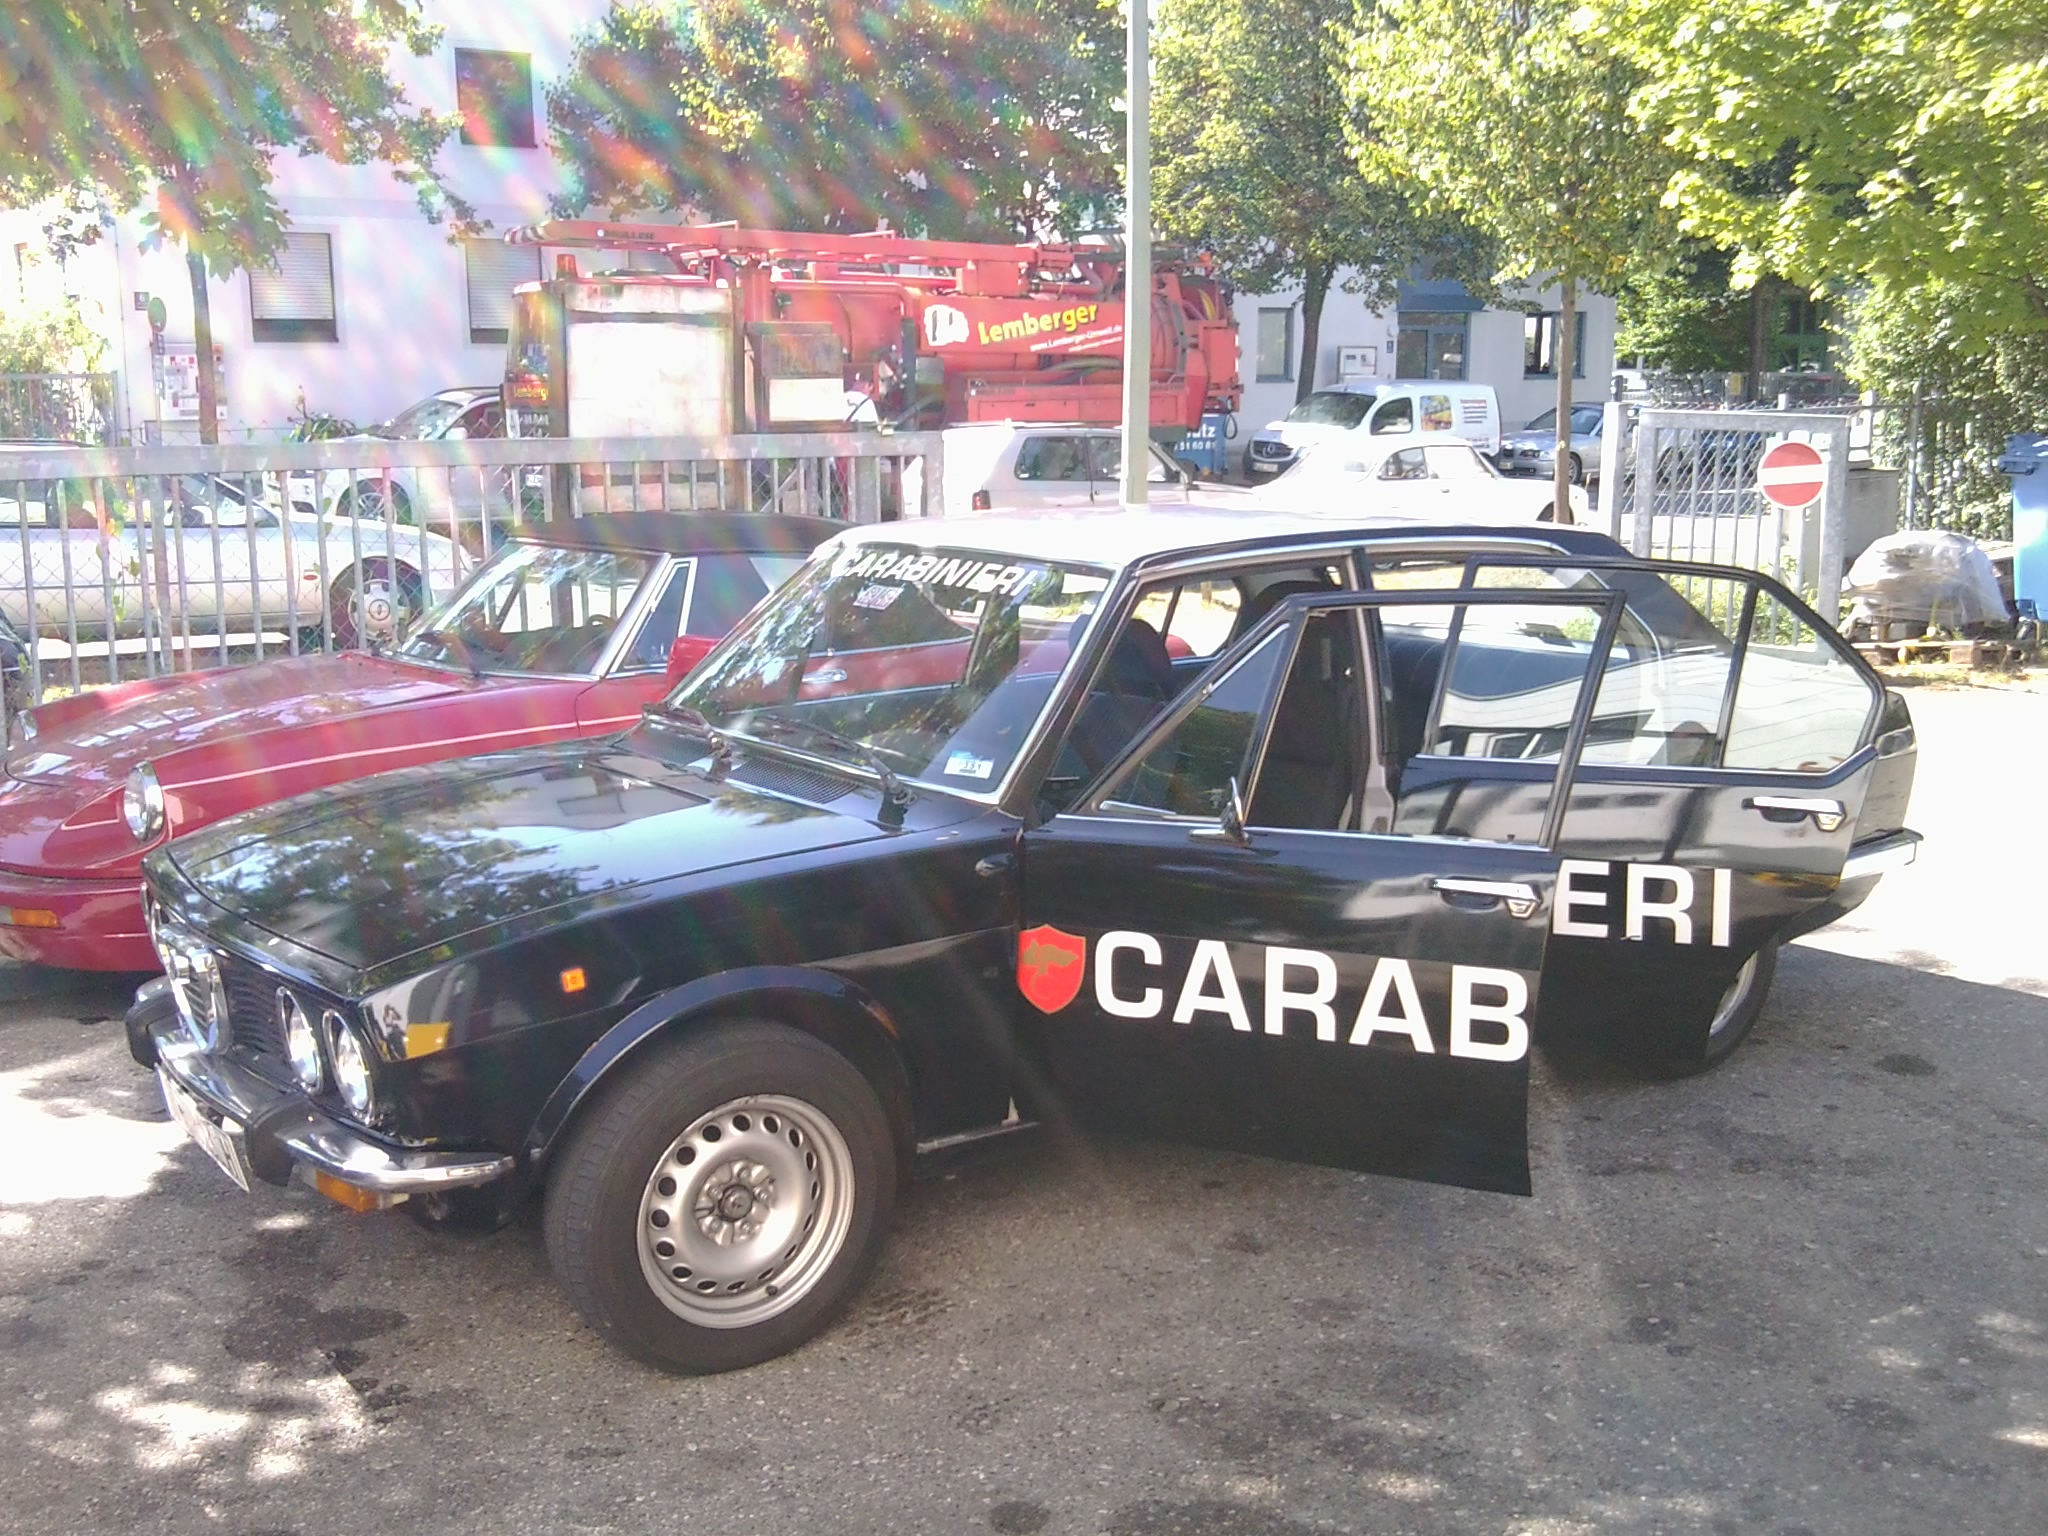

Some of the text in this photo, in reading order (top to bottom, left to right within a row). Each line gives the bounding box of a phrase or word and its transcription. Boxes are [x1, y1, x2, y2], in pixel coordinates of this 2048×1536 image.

[978, 303, 1099, 345] Lemberger
[831, 548, 1038, 597] CARABINIERI
[1552, 859, 1732, 948] ERI
[1094, 930, 1530, 1063] CARAB
